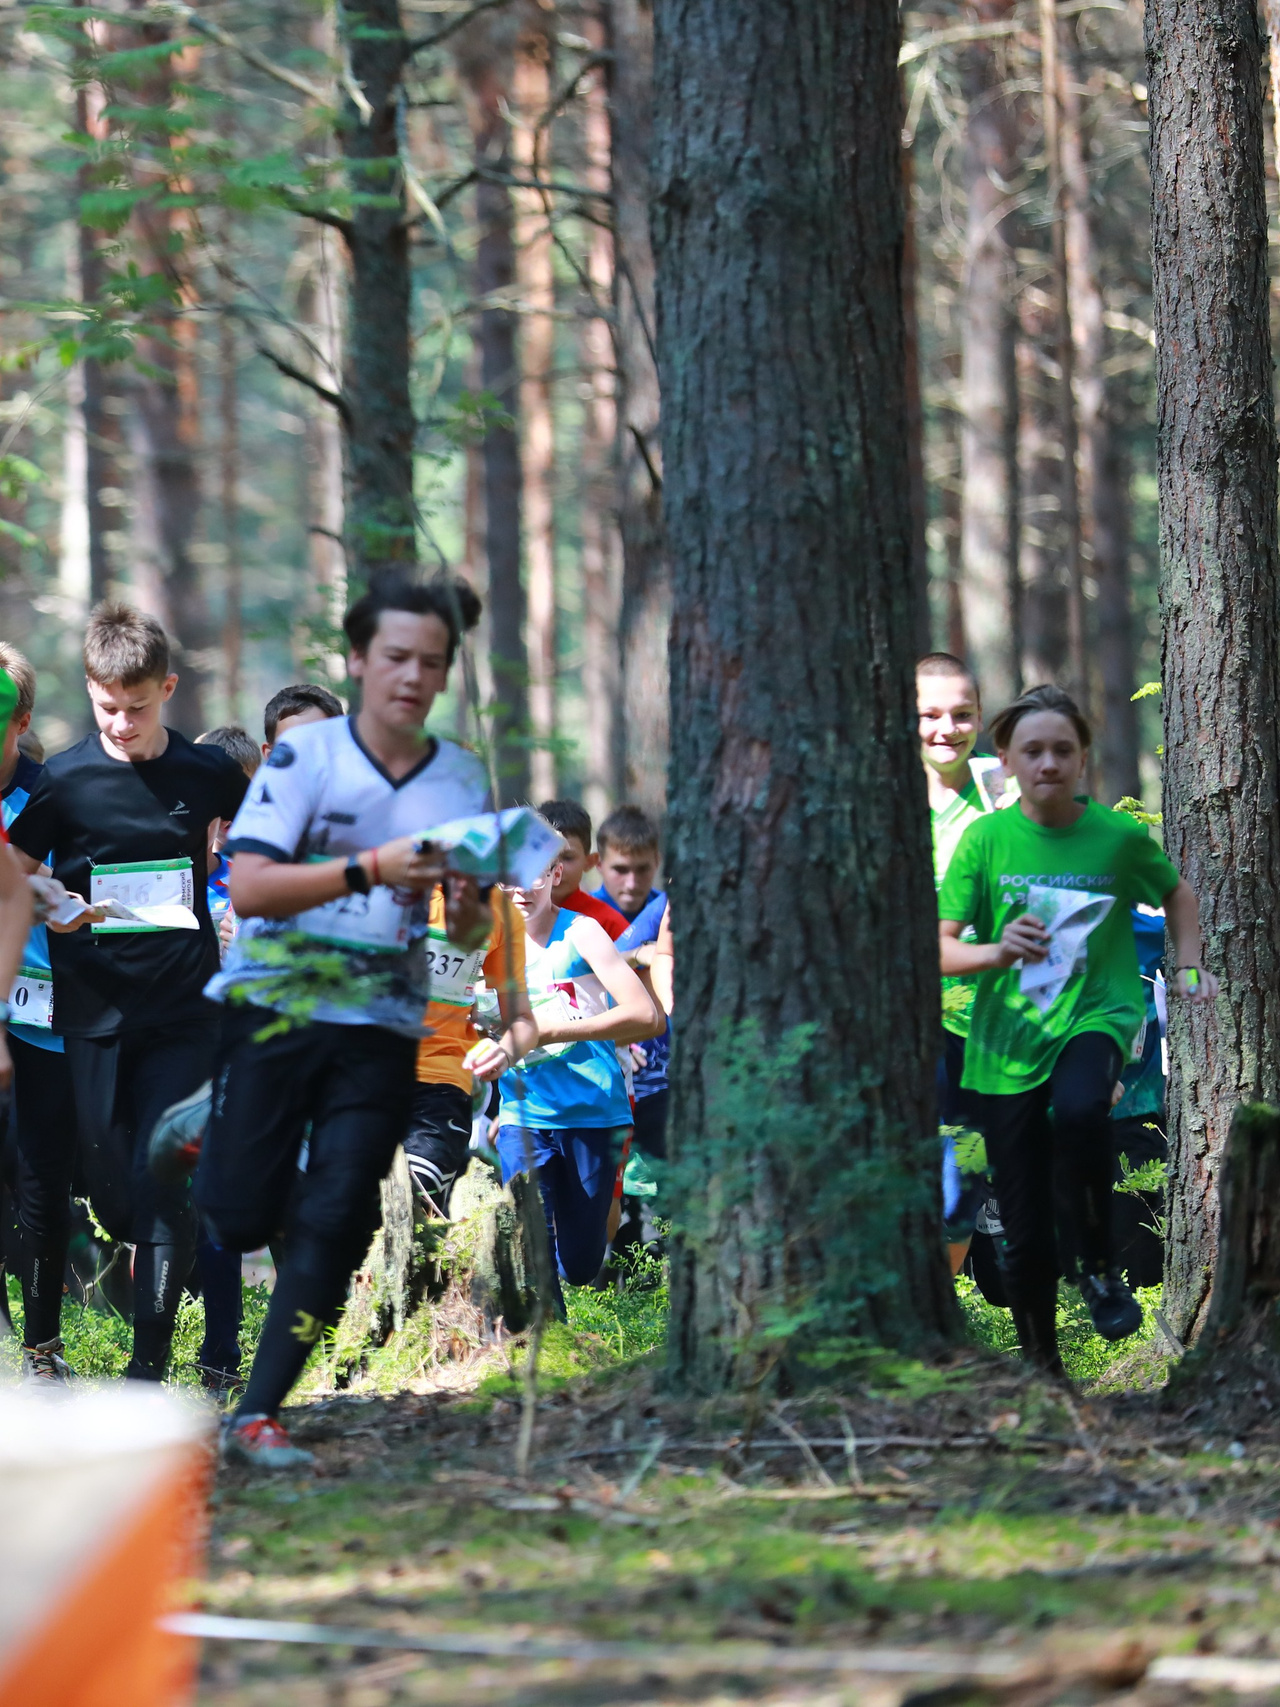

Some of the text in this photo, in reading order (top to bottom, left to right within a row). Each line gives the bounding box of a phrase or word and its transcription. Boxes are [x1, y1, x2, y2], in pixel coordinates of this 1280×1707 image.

[104, 883, 150, 906] 516
[425, 950, 465, 978] 237
[157, 1260, 169, 1299] NORD
